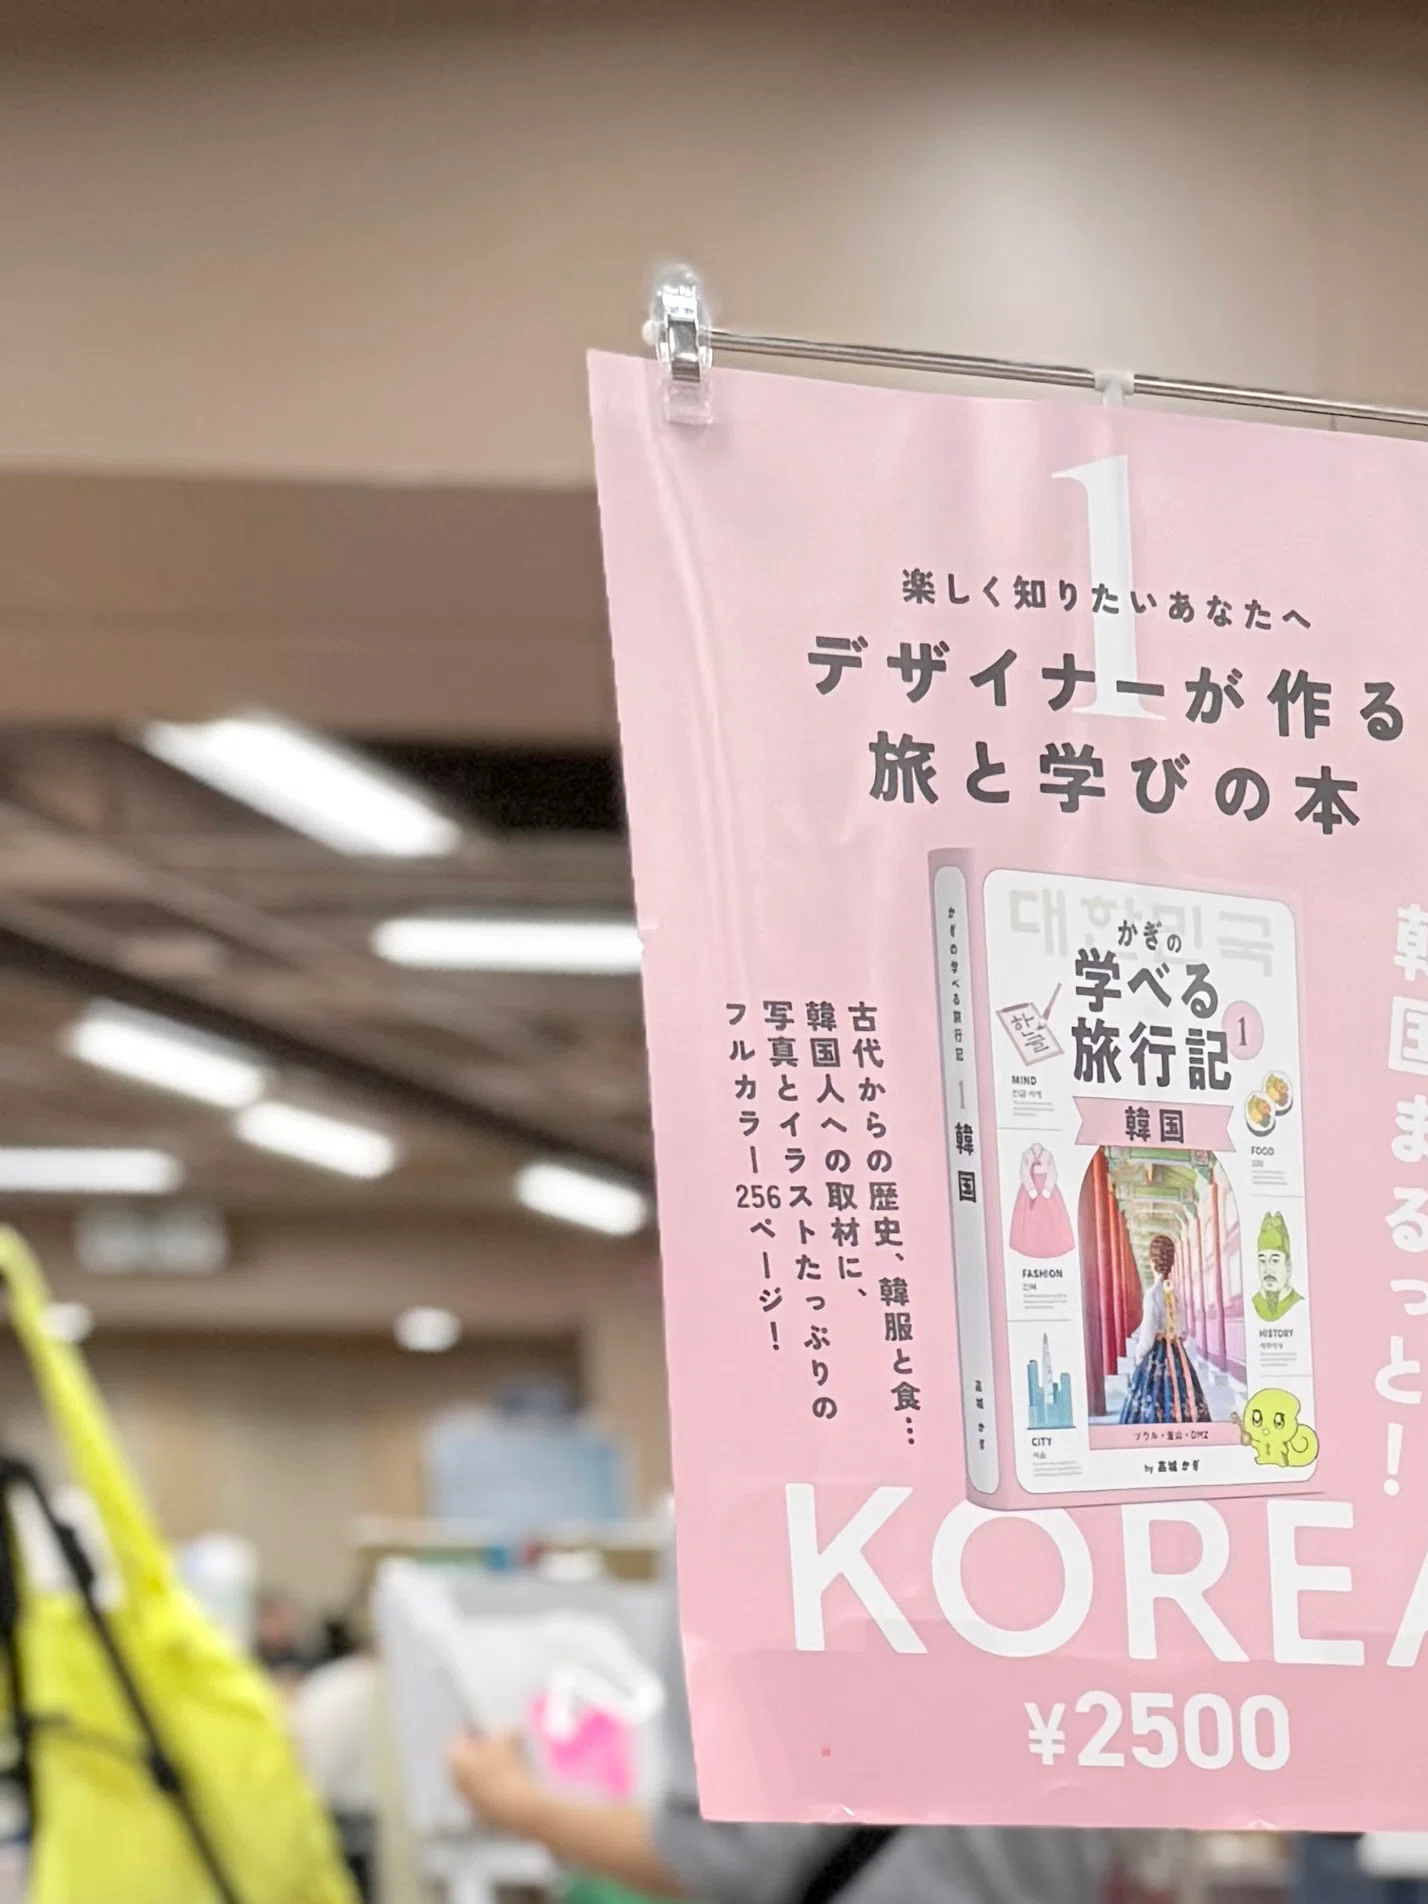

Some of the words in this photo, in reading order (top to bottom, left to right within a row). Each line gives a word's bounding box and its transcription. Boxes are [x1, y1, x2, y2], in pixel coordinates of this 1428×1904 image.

[902, 568, 1312, 631] 楽しく知りたいあなたへ
[807, 634, 1405, 741] デザイナーが作る
[869, 733, 1361, 834] 旅と学びの本
[1118, 920, 1181, 952] かぎの
[1075, 948, 1218, 1019] 学べる
[1072, 1017, 1231, 1090] 旅行記
[1238, 1017, 1247, 1046] 1
[806, 1001, 868, 1296] 韓国人への取材に、
[1125, 1106, 1184, 1143] 韓国
[954, 1122, 976, 1202] 韓国
[763, 1000, 837, 1419] 写真とイラストたっぷりの
[1023, 1269, 1063, 1278] FASHION
[1260, 1329, 1293, 1338] HISTORY
[1032, 1437, 1051, 1446] CITY
[1026, 1691, 1290, 1768] ¥2500
